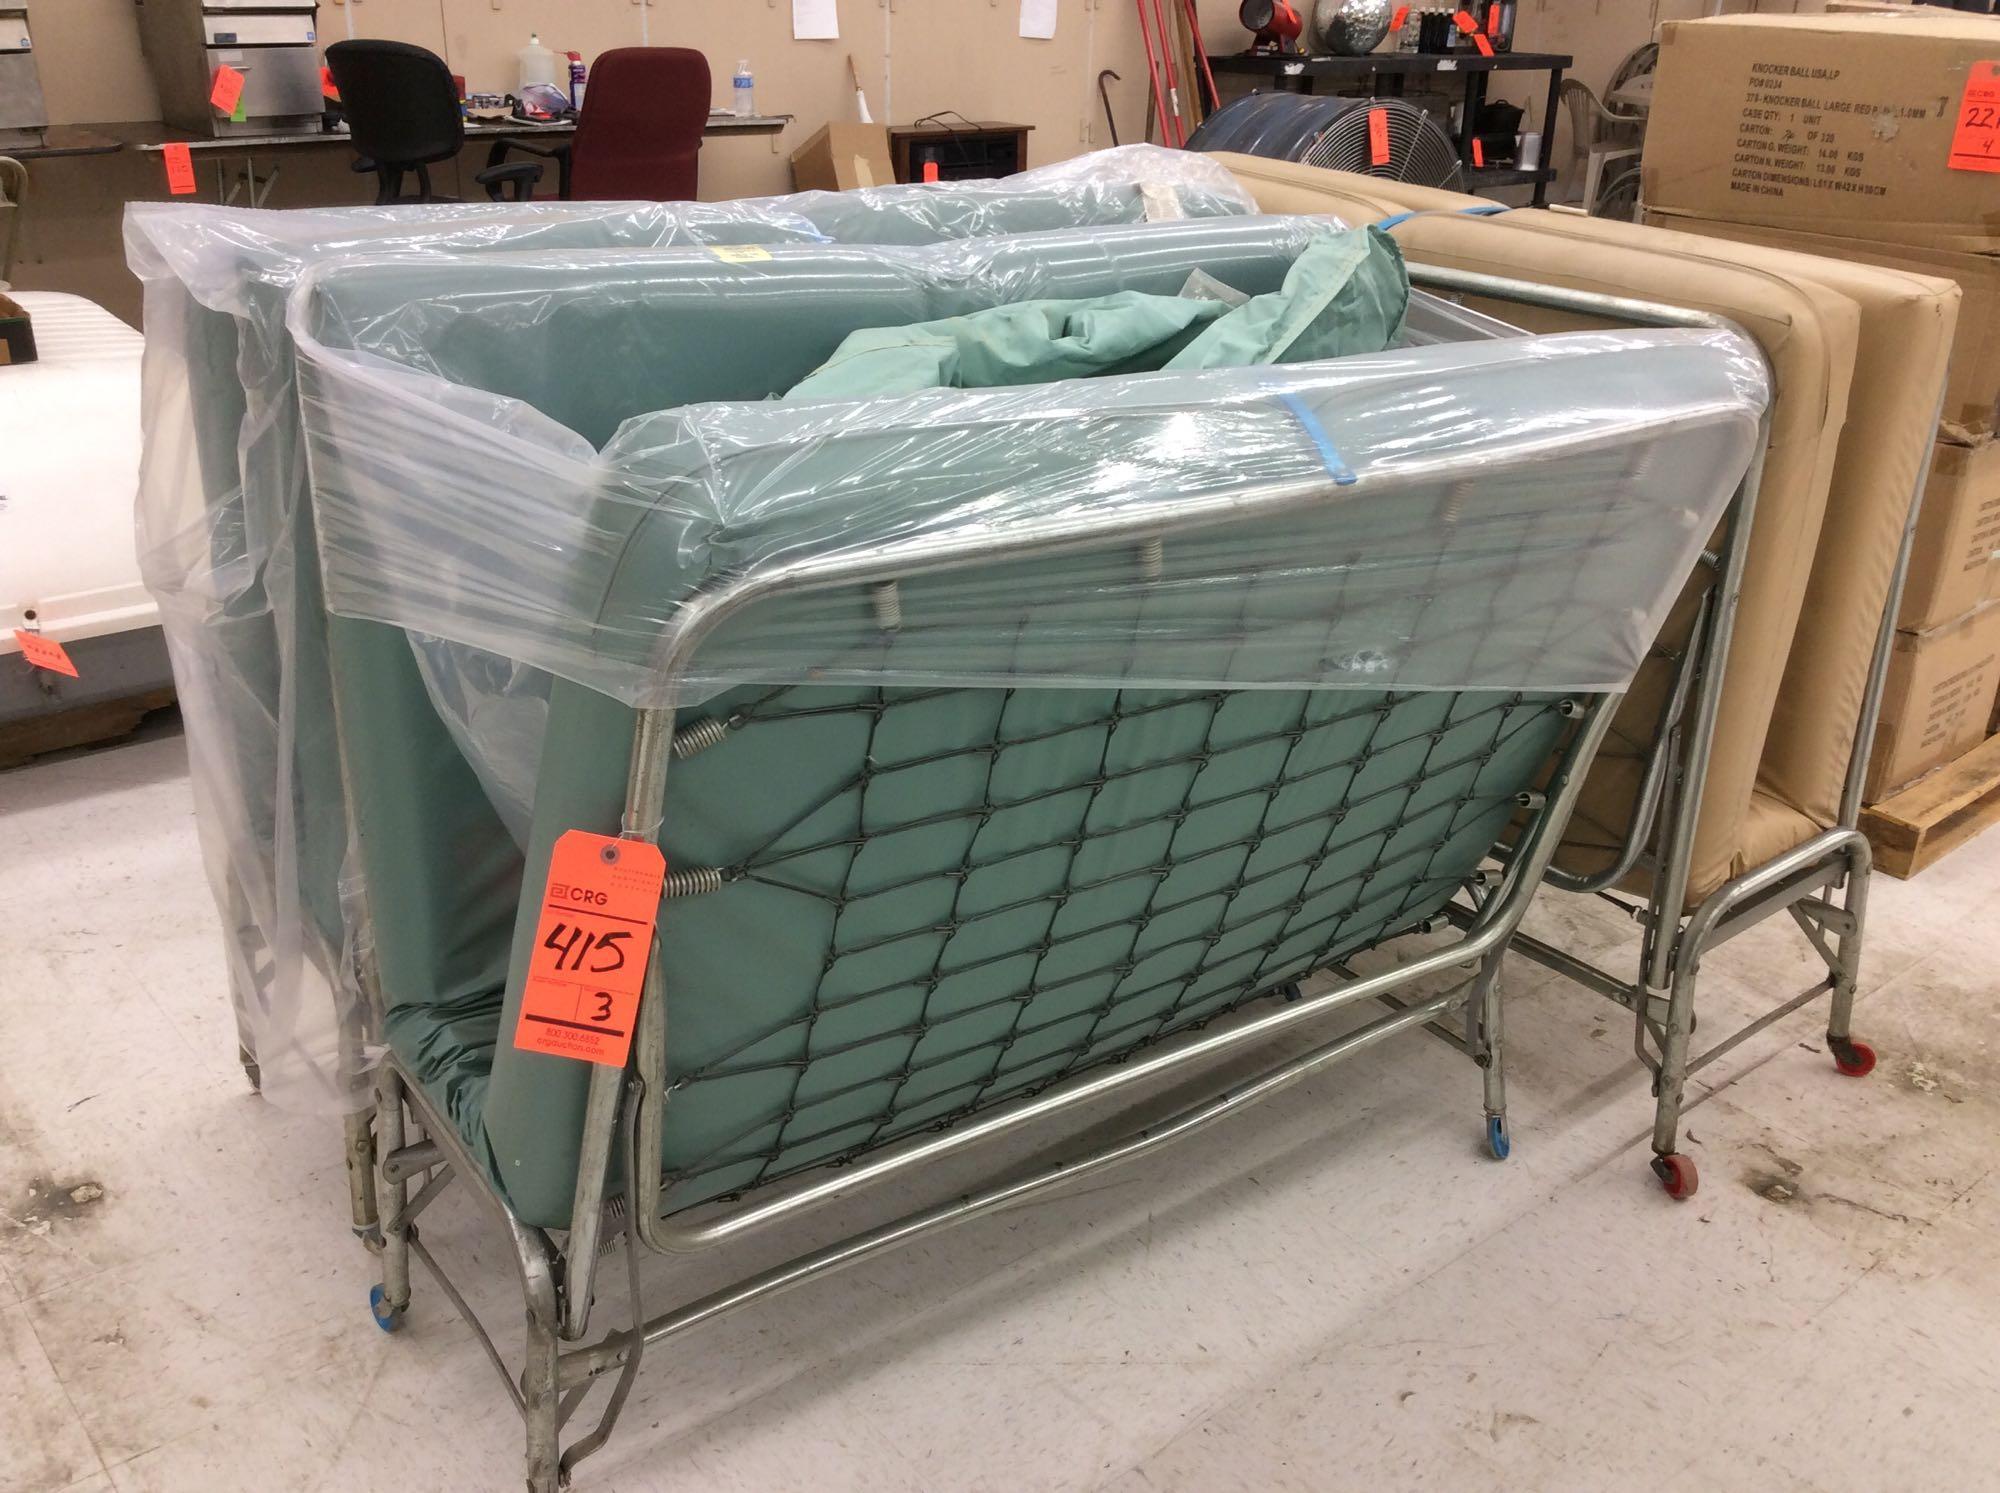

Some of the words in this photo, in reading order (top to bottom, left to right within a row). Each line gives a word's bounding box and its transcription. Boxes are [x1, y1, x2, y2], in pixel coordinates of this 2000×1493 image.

[1752, 63, 1789, 76] KNOCKER
[1790, 66, 1809, 78] BALL
[1801, 97, 1820, 109] BALL
[1823, 100, 1851, 113] LARGE
[1854, 103, 1871, 115] RED
[1743, 108, 1762, 119] CASE
[1803, 115, 1822, 126] UNIT
[1808, 130, 1819, 141] OF
[1737, 138, 1767, 151] CARTON
[1983, 139, 1994, 153] 4
[1734, 153, 1765, 166] CARTON
[1732, 167, 1761, 180] CARTON
[1730, 181, 1751, 193] MADE
[1752, 184, 1760, 194] IN
[1761, 185, 1784, 197] CHINA
[570, 887, 608, 906] CRG
[544, 922, 633, 972] 415
[591, 992, 613, 1022] 3
